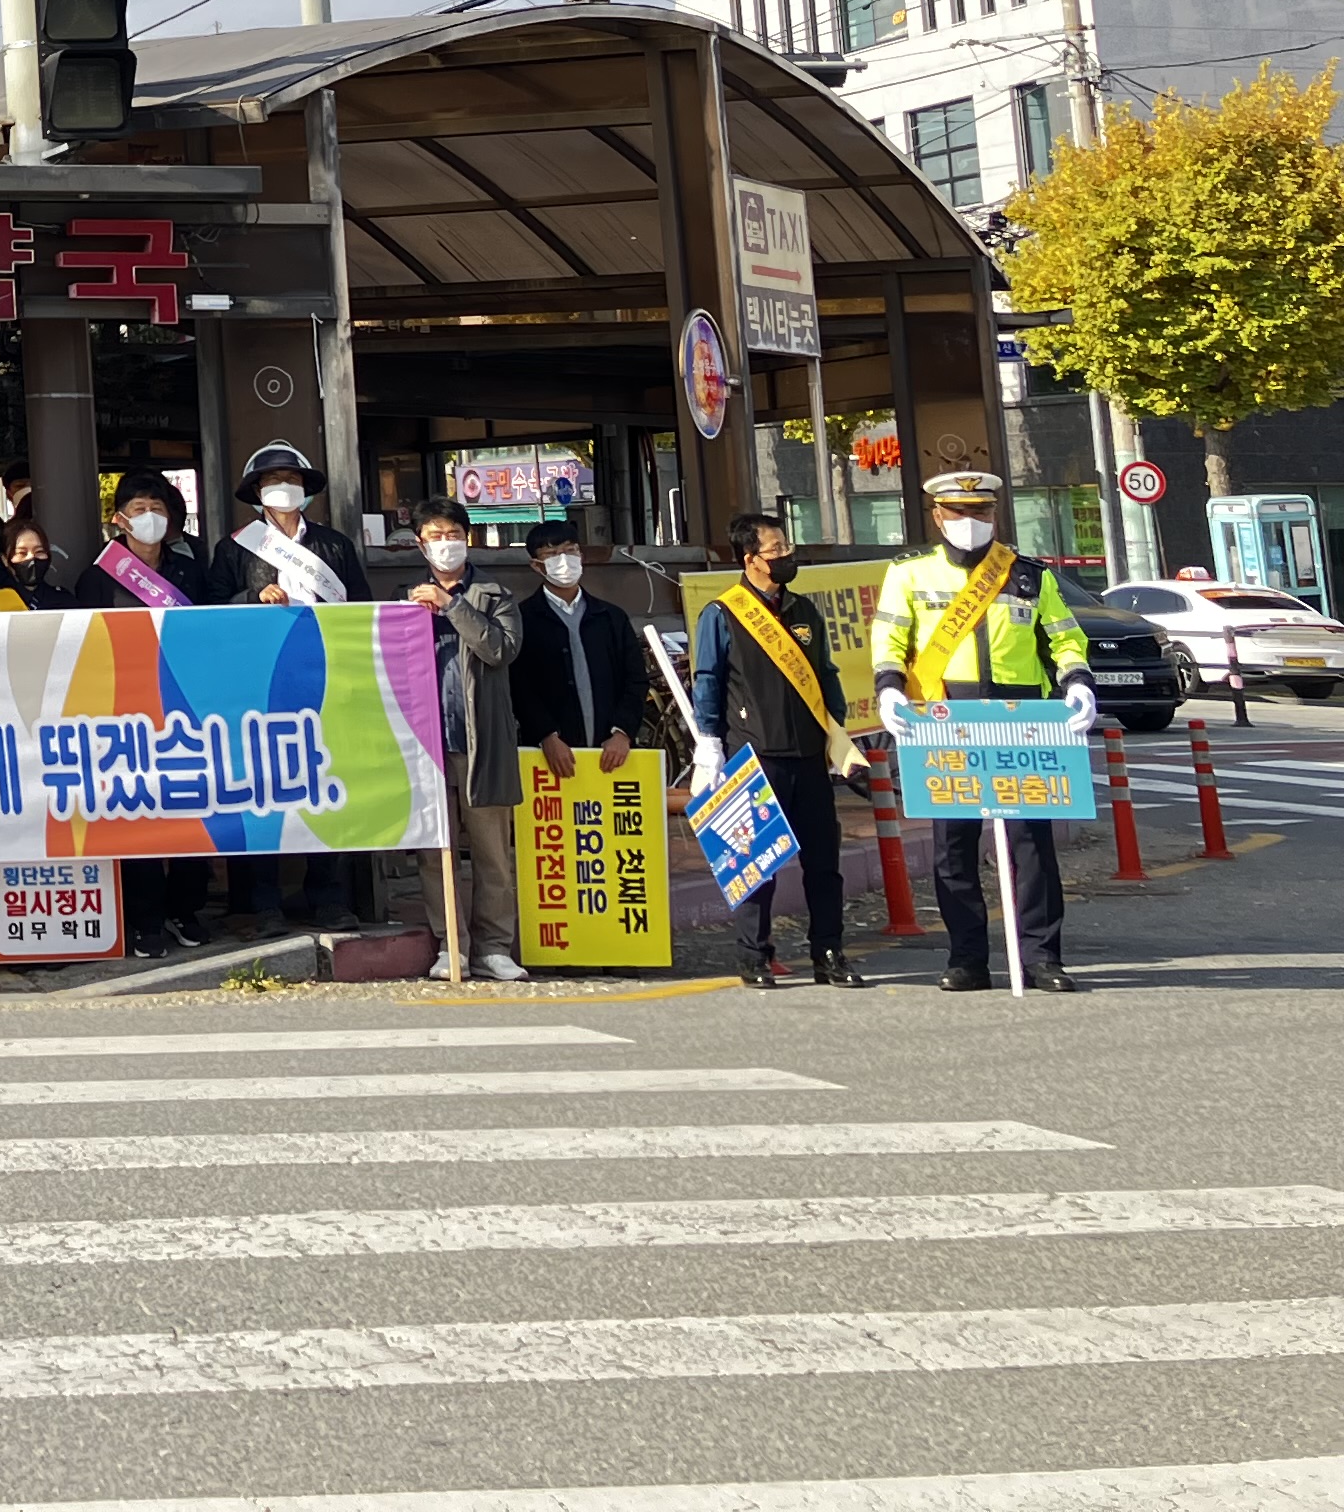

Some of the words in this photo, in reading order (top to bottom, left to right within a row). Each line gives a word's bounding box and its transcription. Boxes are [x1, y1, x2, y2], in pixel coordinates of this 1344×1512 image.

[766, 208, 805, 255] TAXI
[1129, 473, 1156, 491] 50
[40, 710, 342, 816] 뛰겠습니다.
[924, 749, 987, 772] 사람이
[996, 750, 1066, 771] 보이면,
[925, 775, 982, 805] 일단
[991, 775, 1071, 806] 멈춤!!
[613, 781, 644, 836] 매월
[532, 766, 567, 910] 교통안전의
[573, 800, 608, 915] 월요일은
[3, 865, 74, 887] 횡단보도
[82, 864, 99, 885] 앞
[615, 848, 649, 934] 첫째주
[4, 889, 102, 917] 일시정지
[8, 921, 48, 940] 의무
[61, 919, 101, 939] 확대
[539, 921, 569, 950] 날
